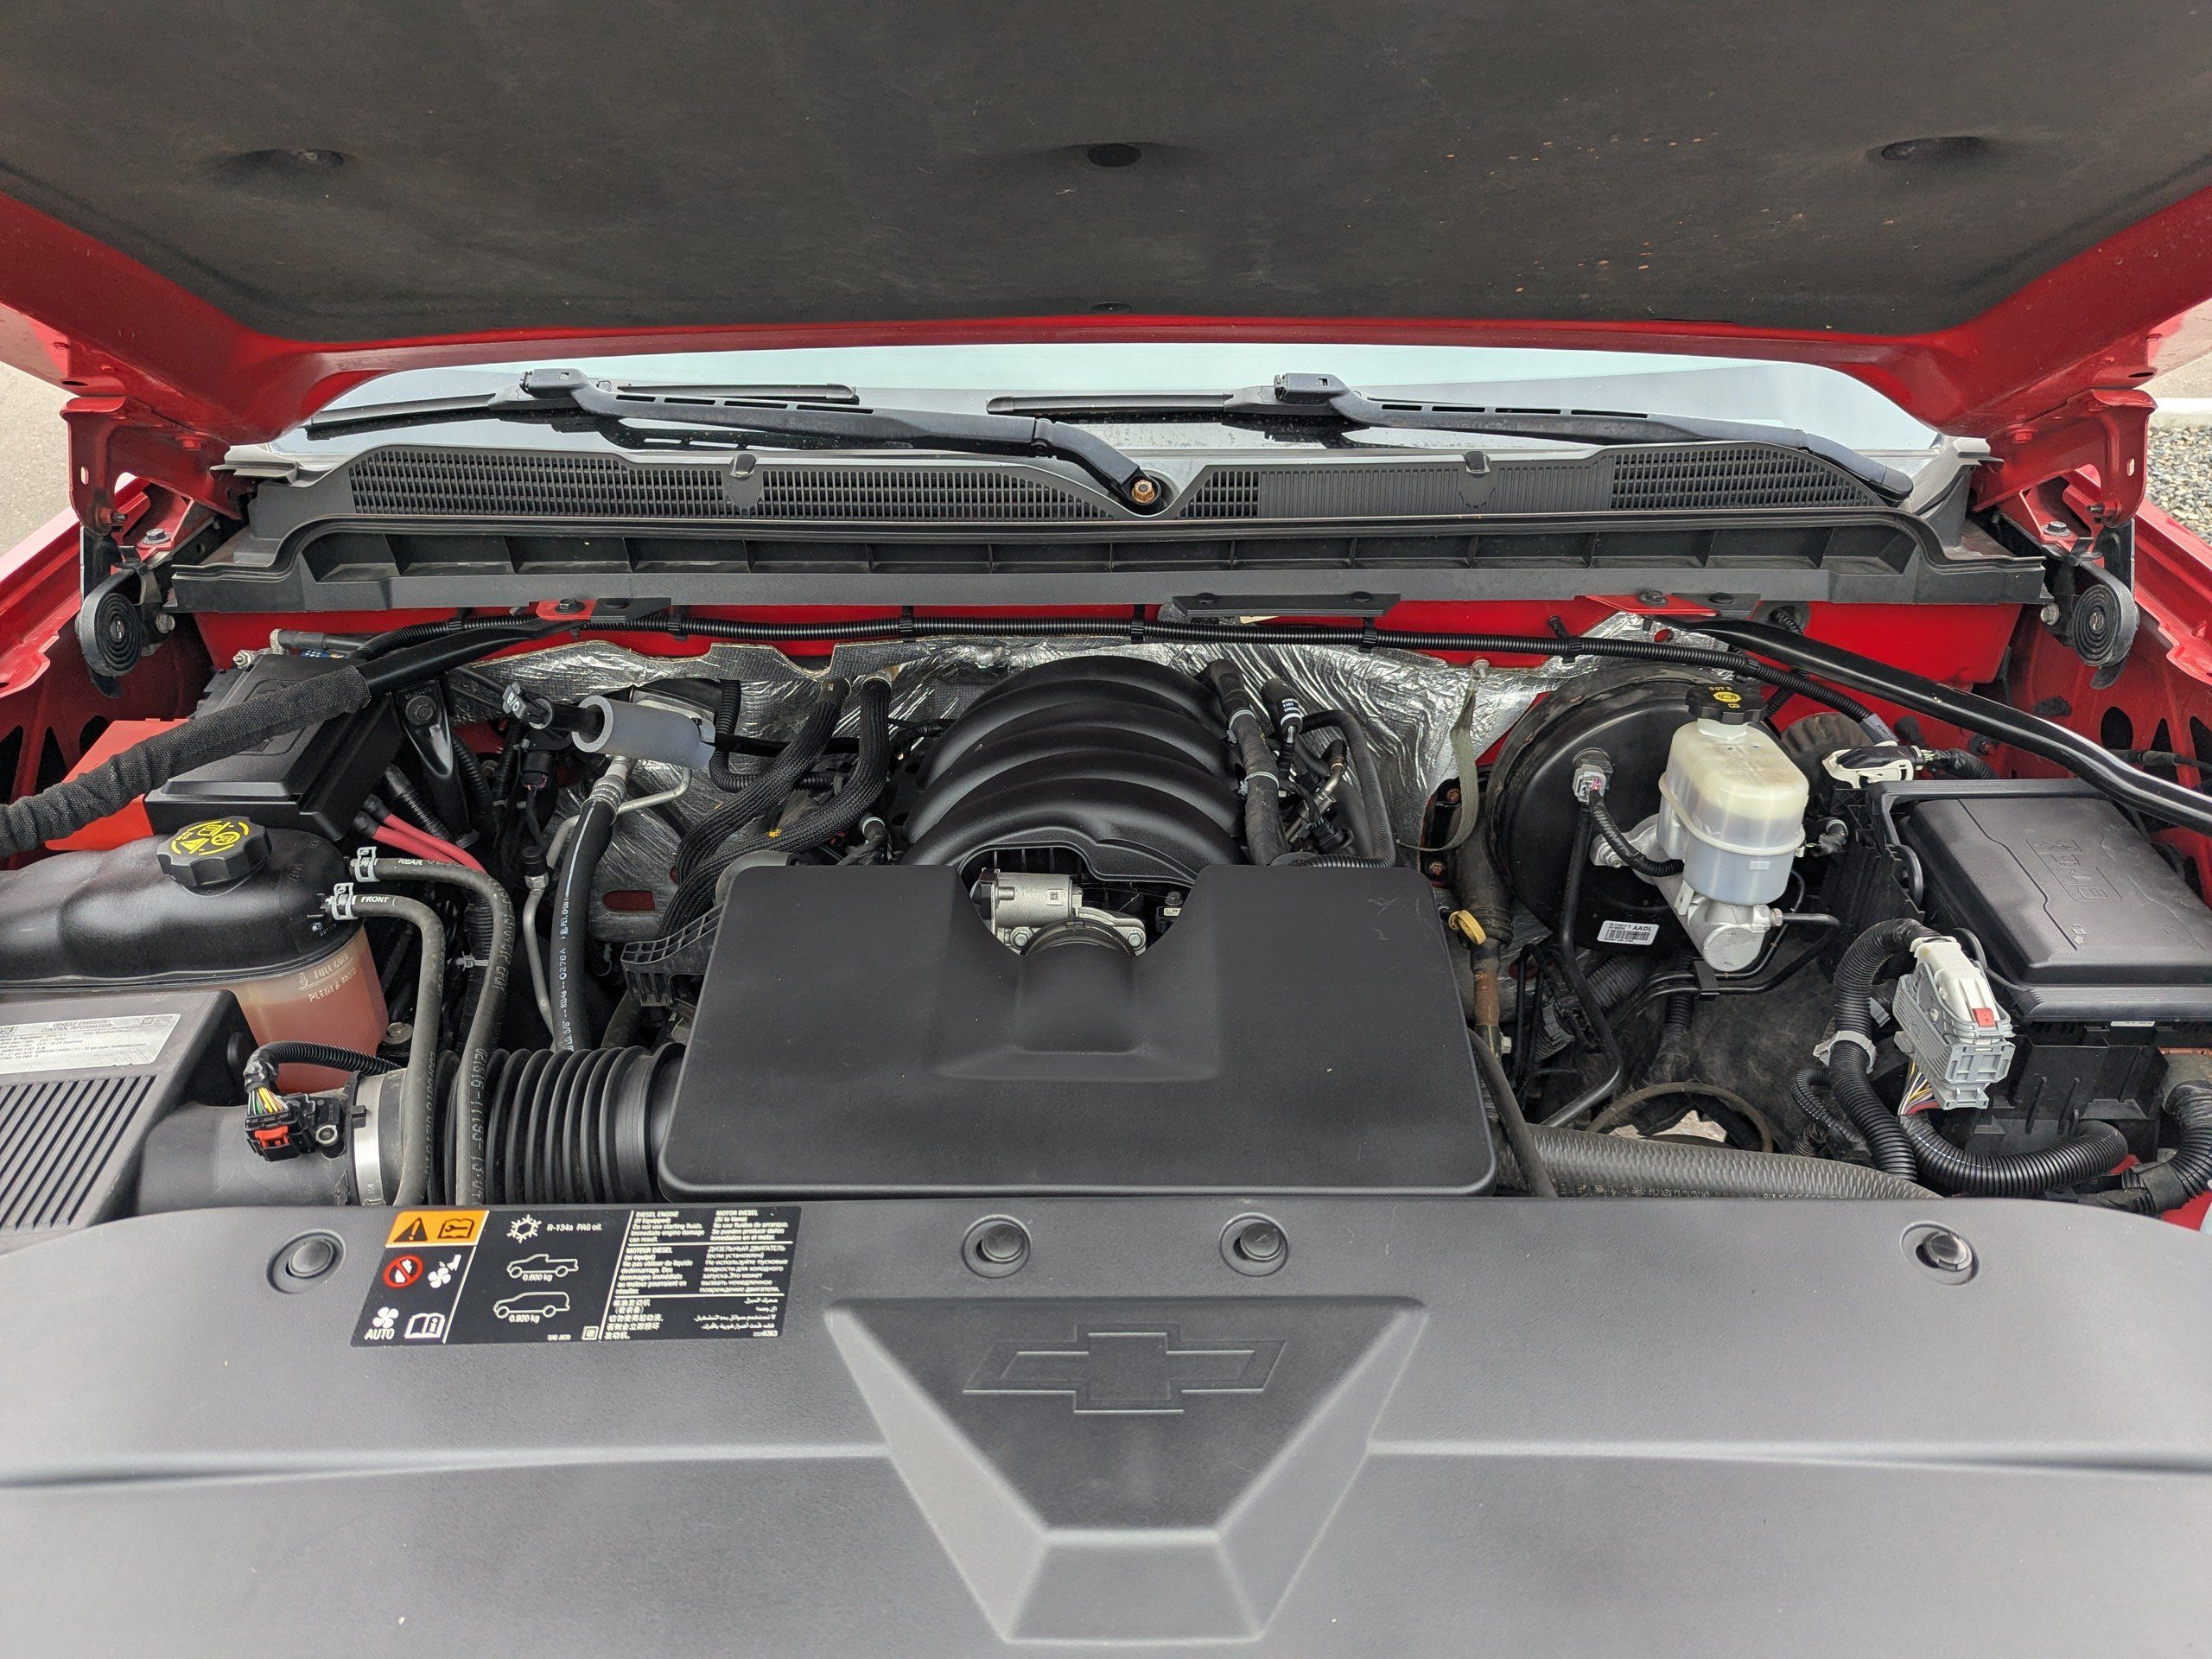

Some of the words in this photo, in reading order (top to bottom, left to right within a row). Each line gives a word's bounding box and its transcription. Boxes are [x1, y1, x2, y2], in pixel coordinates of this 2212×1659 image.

[360, 895, 390, 904] FRONT
[314, 964, 333, 979] FULL
[308, 985, 334, 1001] PLEIN
[543, 1274, 553, 1282] kg
[530, 1314, 540, 1324] kg
[364, 1328, 395, 1340] AUTO
